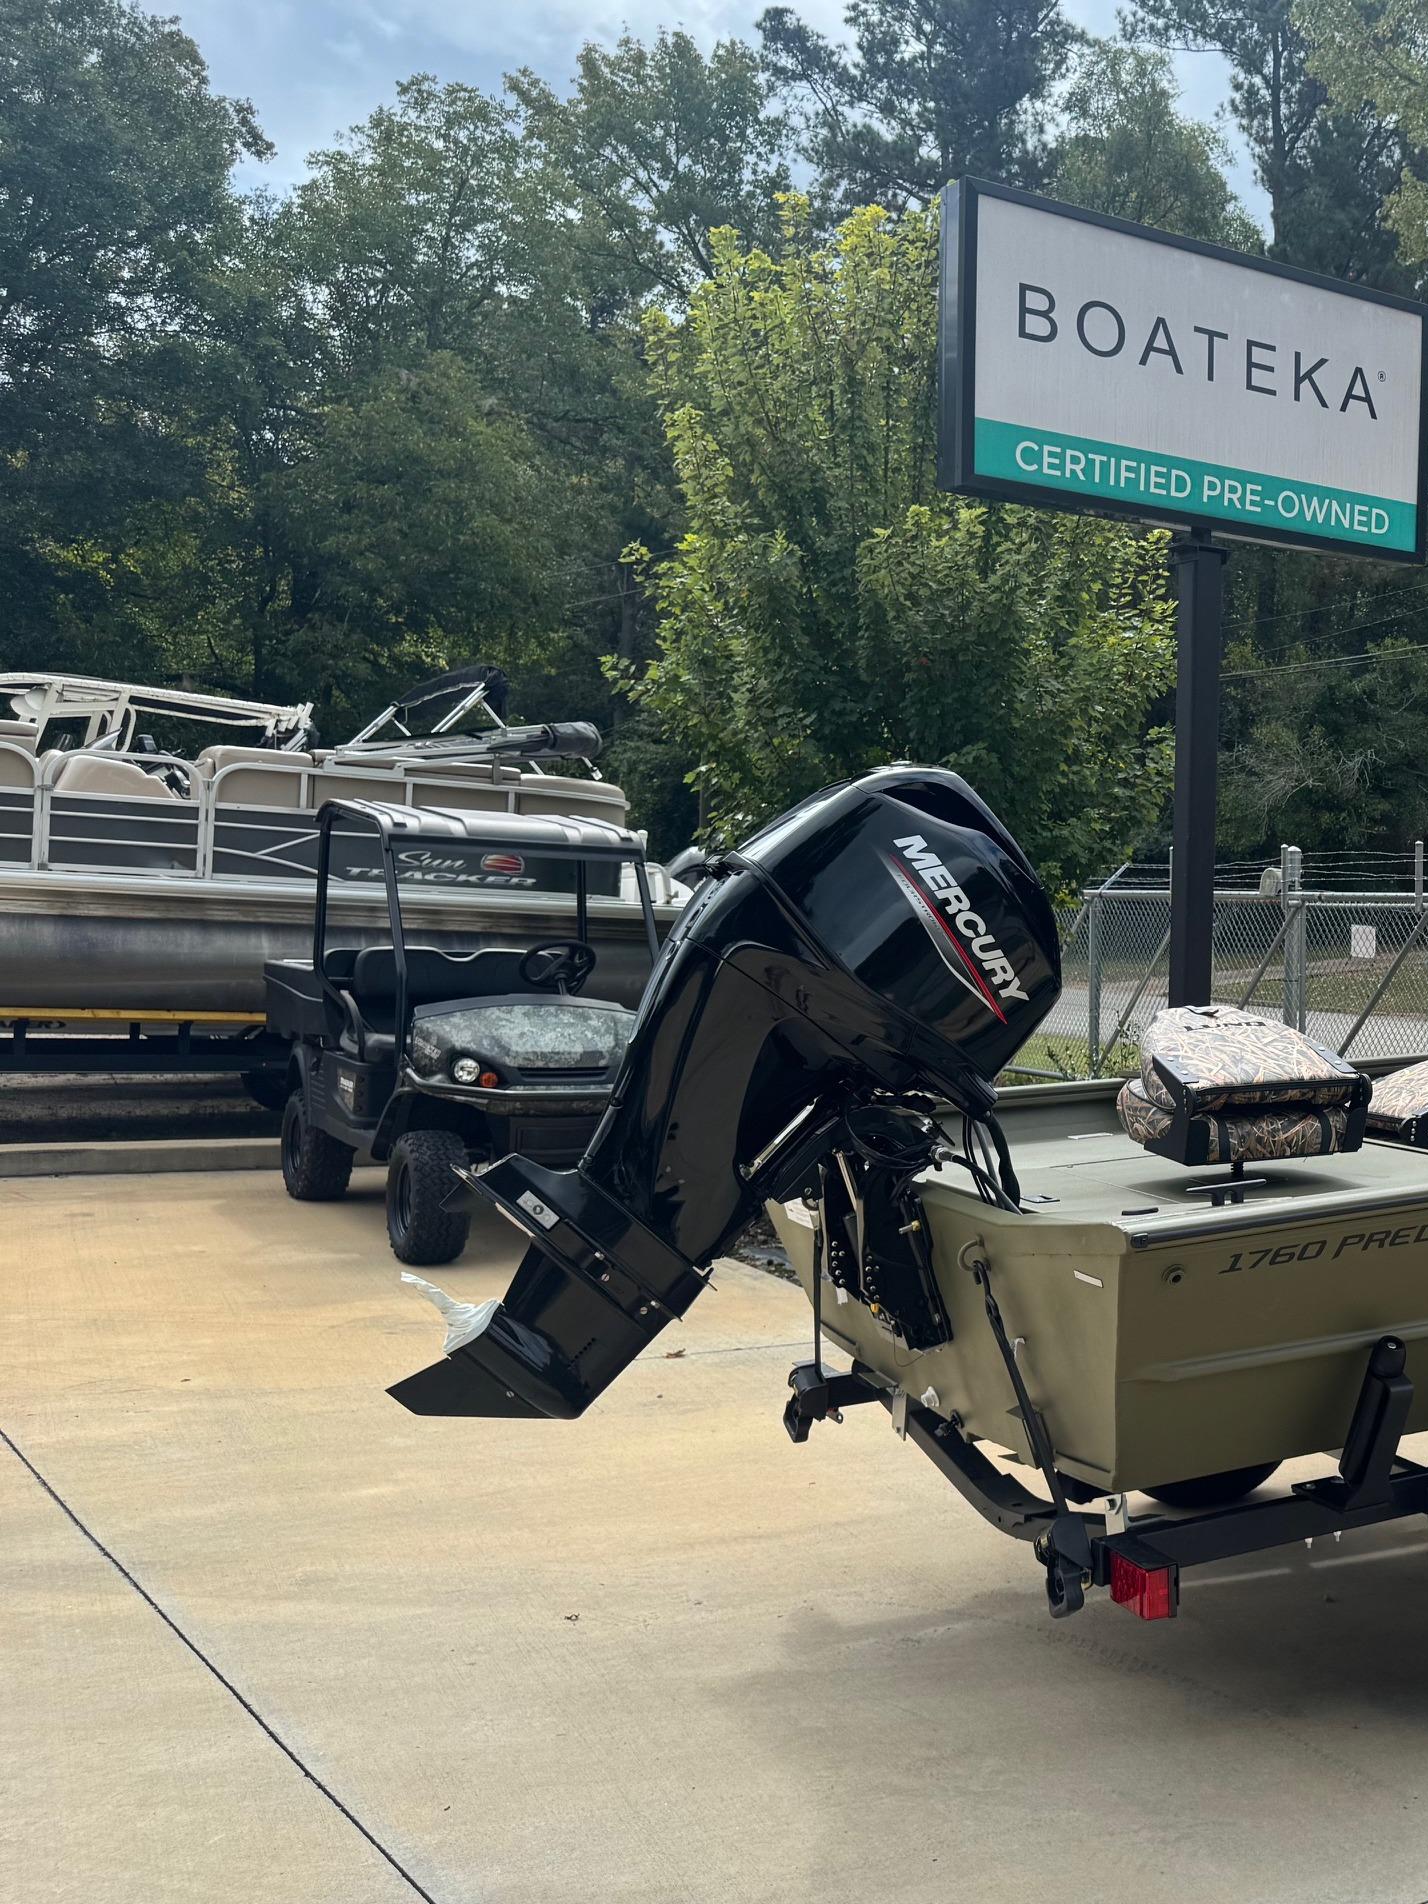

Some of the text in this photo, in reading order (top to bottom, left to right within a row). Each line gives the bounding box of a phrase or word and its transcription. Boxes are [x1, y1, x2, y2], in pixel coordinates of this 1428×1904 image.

[1015, 440, 1390, 535] CERTIFIED PRE-OWNED
[398, 850, 468, 870] Sun
[892, 834, 1030, 1001] MERCURY
[1218, 1239, 1328, 1275] 1760
